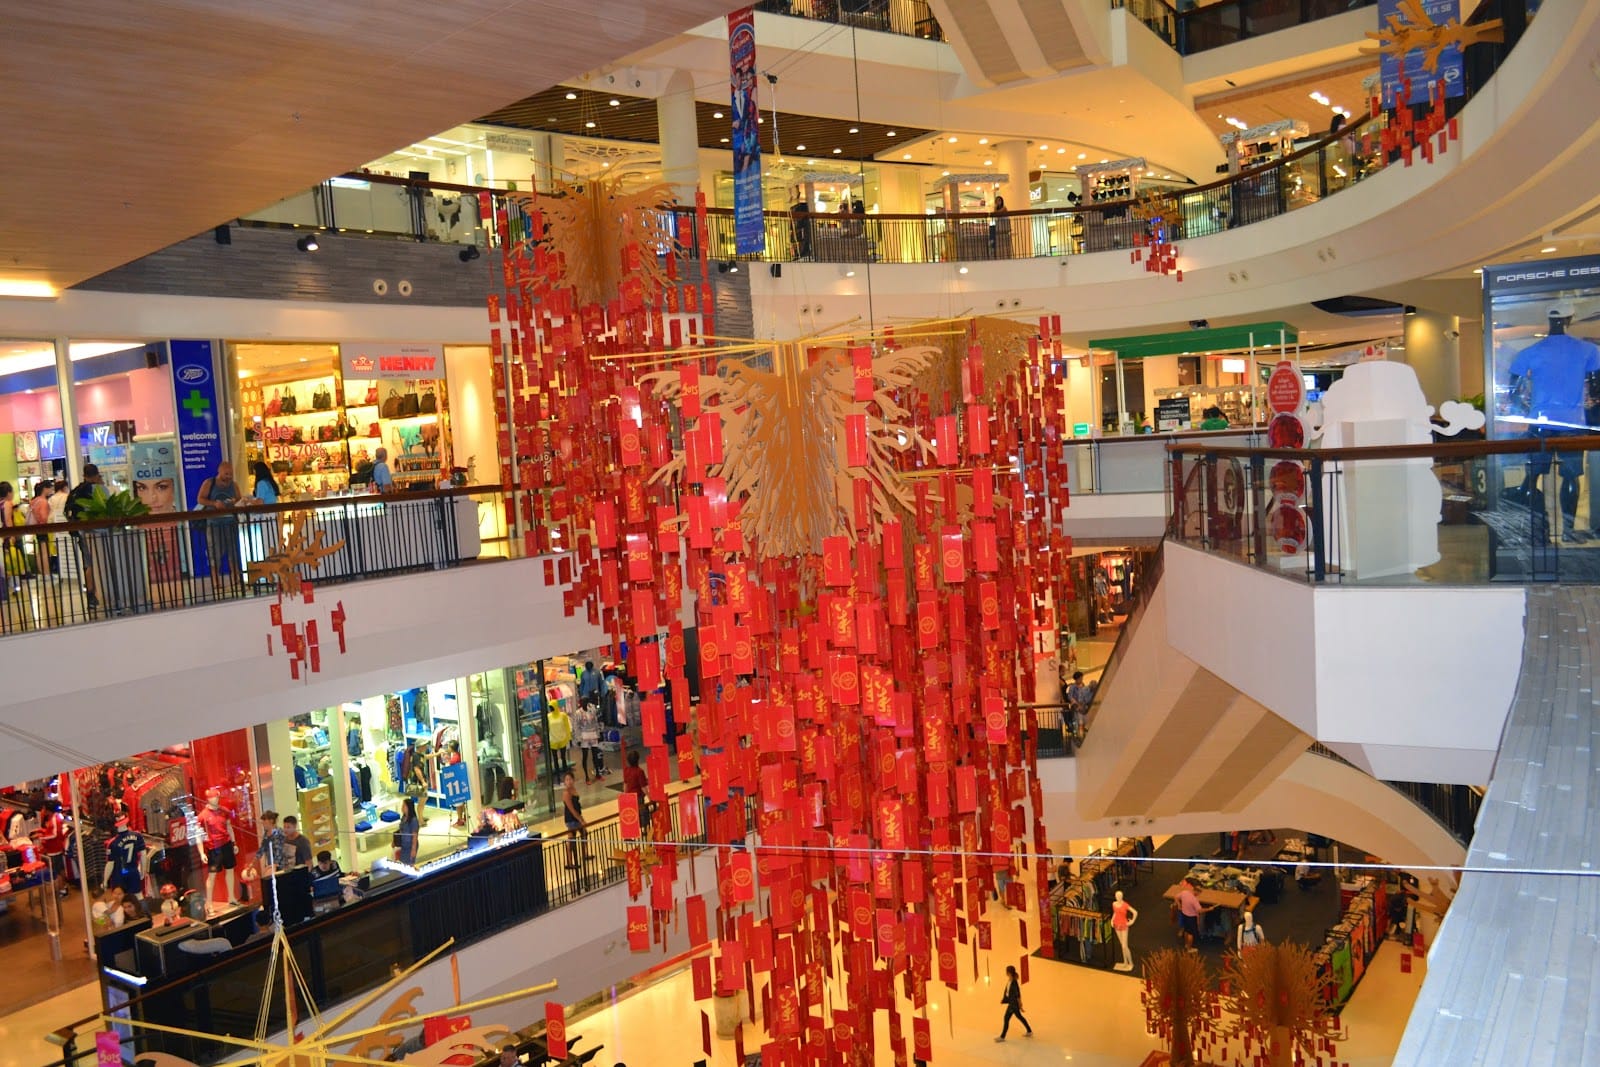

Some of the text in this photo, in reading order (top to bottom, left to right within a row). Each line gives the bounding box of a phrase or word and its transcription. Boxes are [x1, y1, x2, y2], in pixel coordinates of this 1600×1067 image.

[1496, 266, 1600, 283] PORSCHE DES
[379, 356, 436, 371] HENRY
[182, 432, 217, 441] welcome
[253, 421, 290, 441] Sale
[1477, 469, 1487, 493] 3
[446, 780, 461, 797] 11
[124, 843, 134, 863] 7
